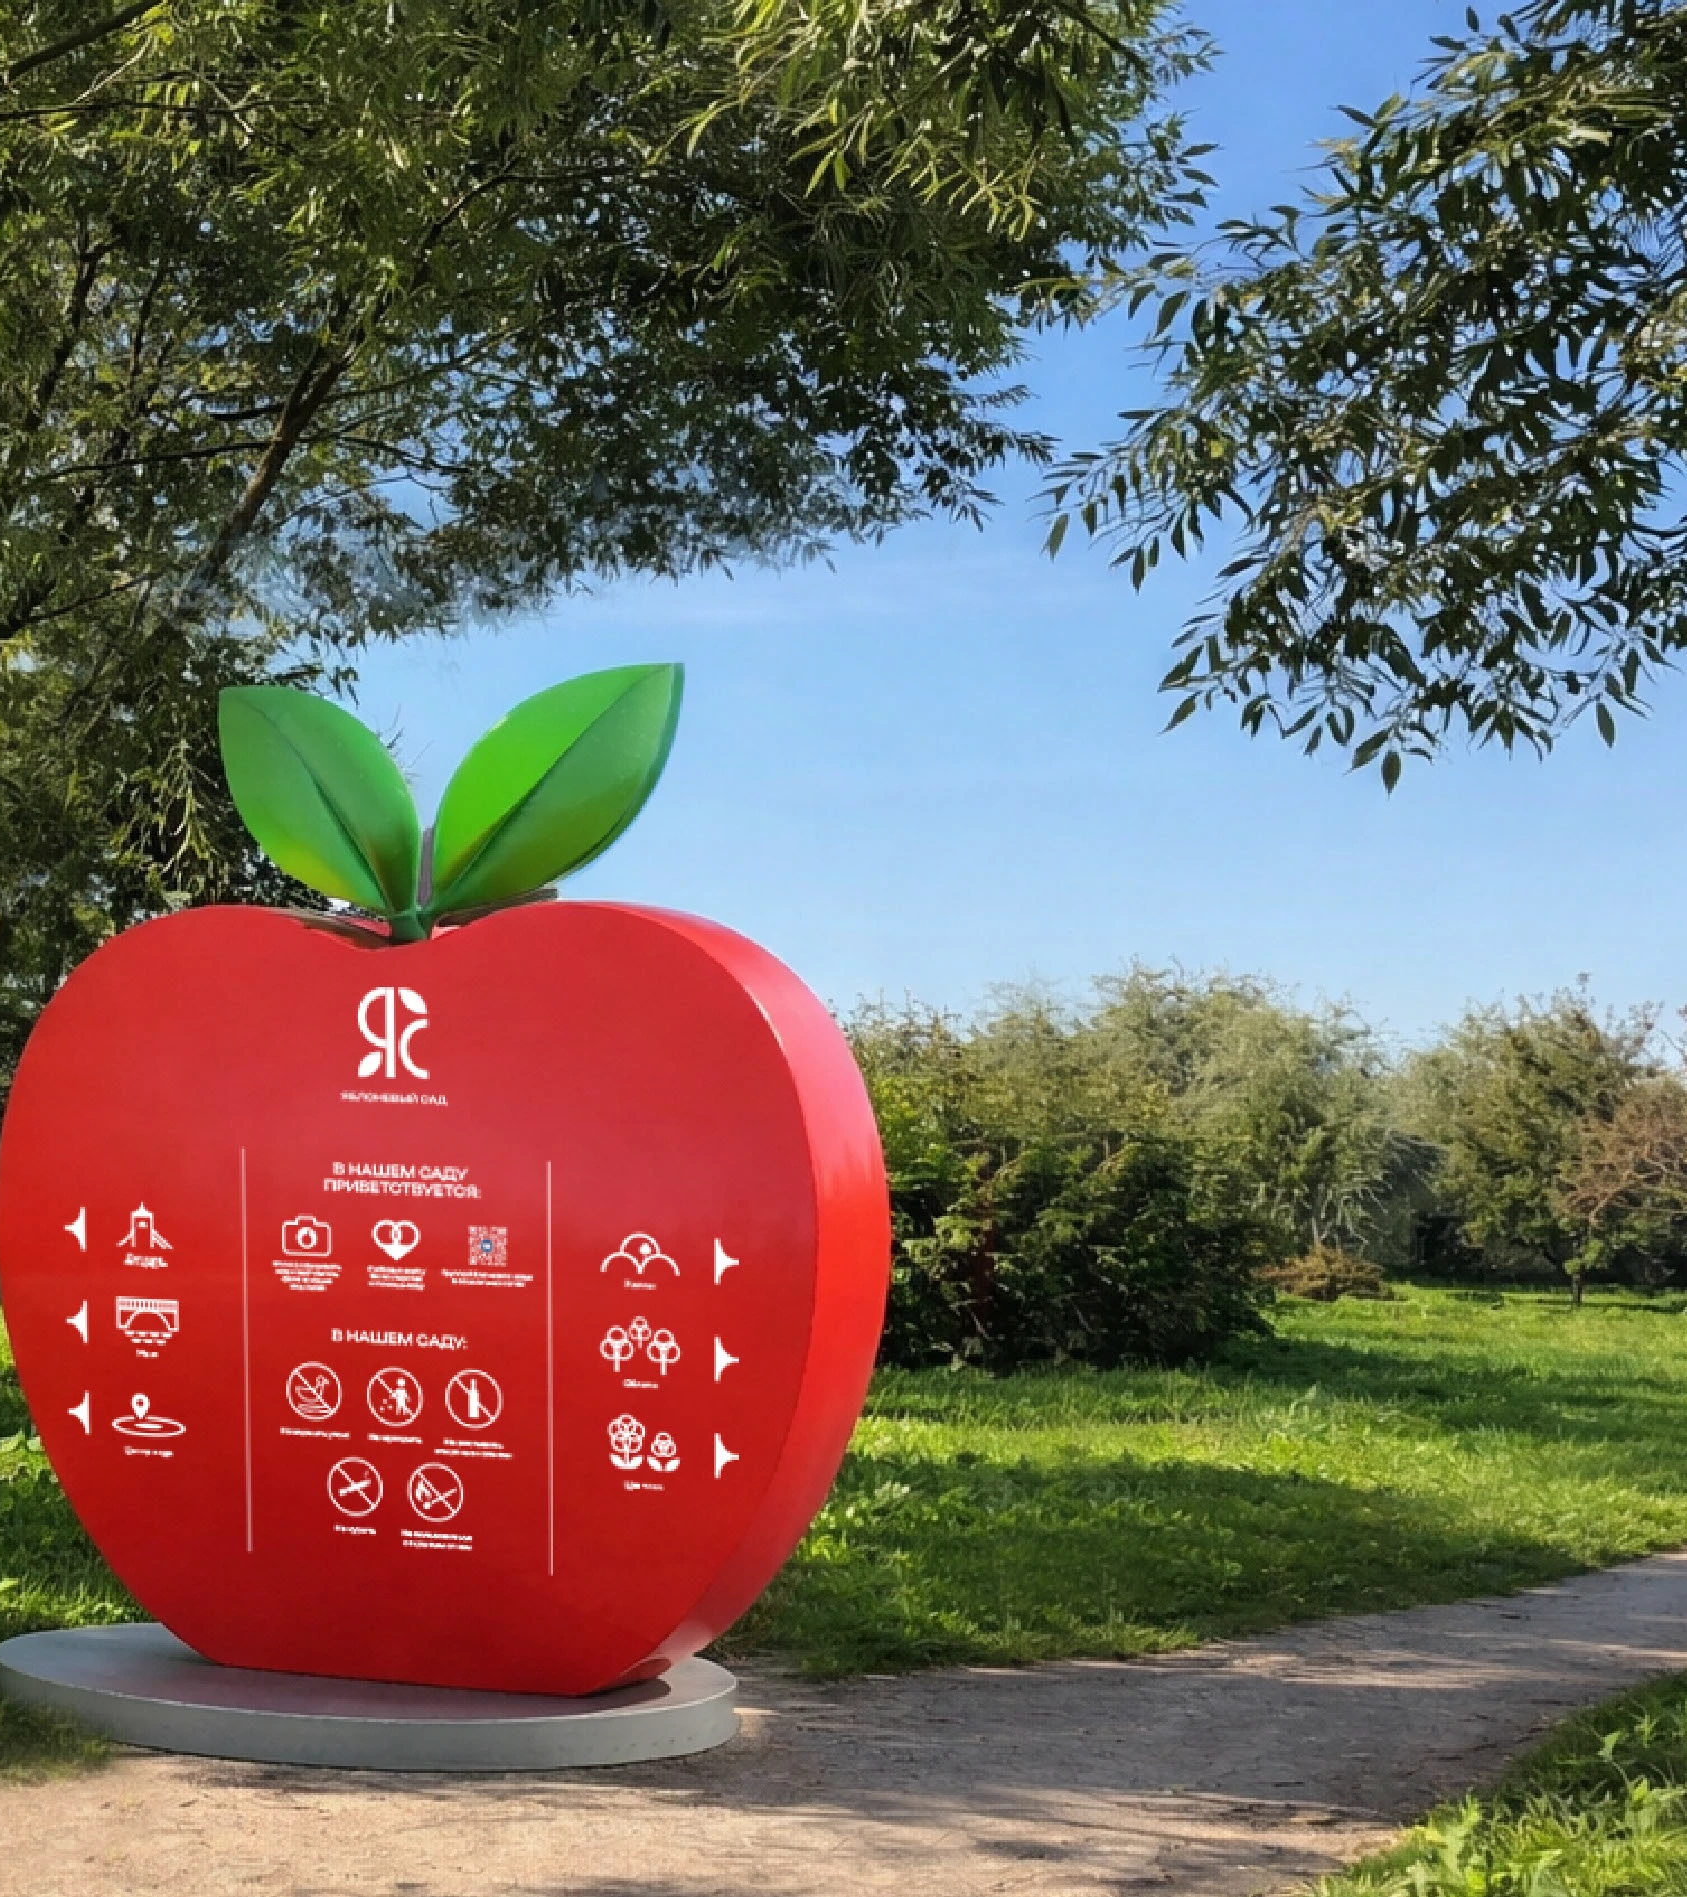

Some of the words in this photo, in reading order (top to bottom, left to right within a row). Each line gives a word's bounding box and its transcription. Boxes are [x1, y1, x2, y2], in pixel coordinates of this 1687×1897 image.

[420, 1094, 448, 1106] САД
[332, 1161, 345, 1176] В
[348, 1162, 415, 1179] НАШЕМ
[418, 1165, 469, 1182] САДУ
[331, 1328, 343, 1342] В
[346, 1329, 413, 1346] НАШЕМ
[416, 1331, 468, 1350] САДУ:
